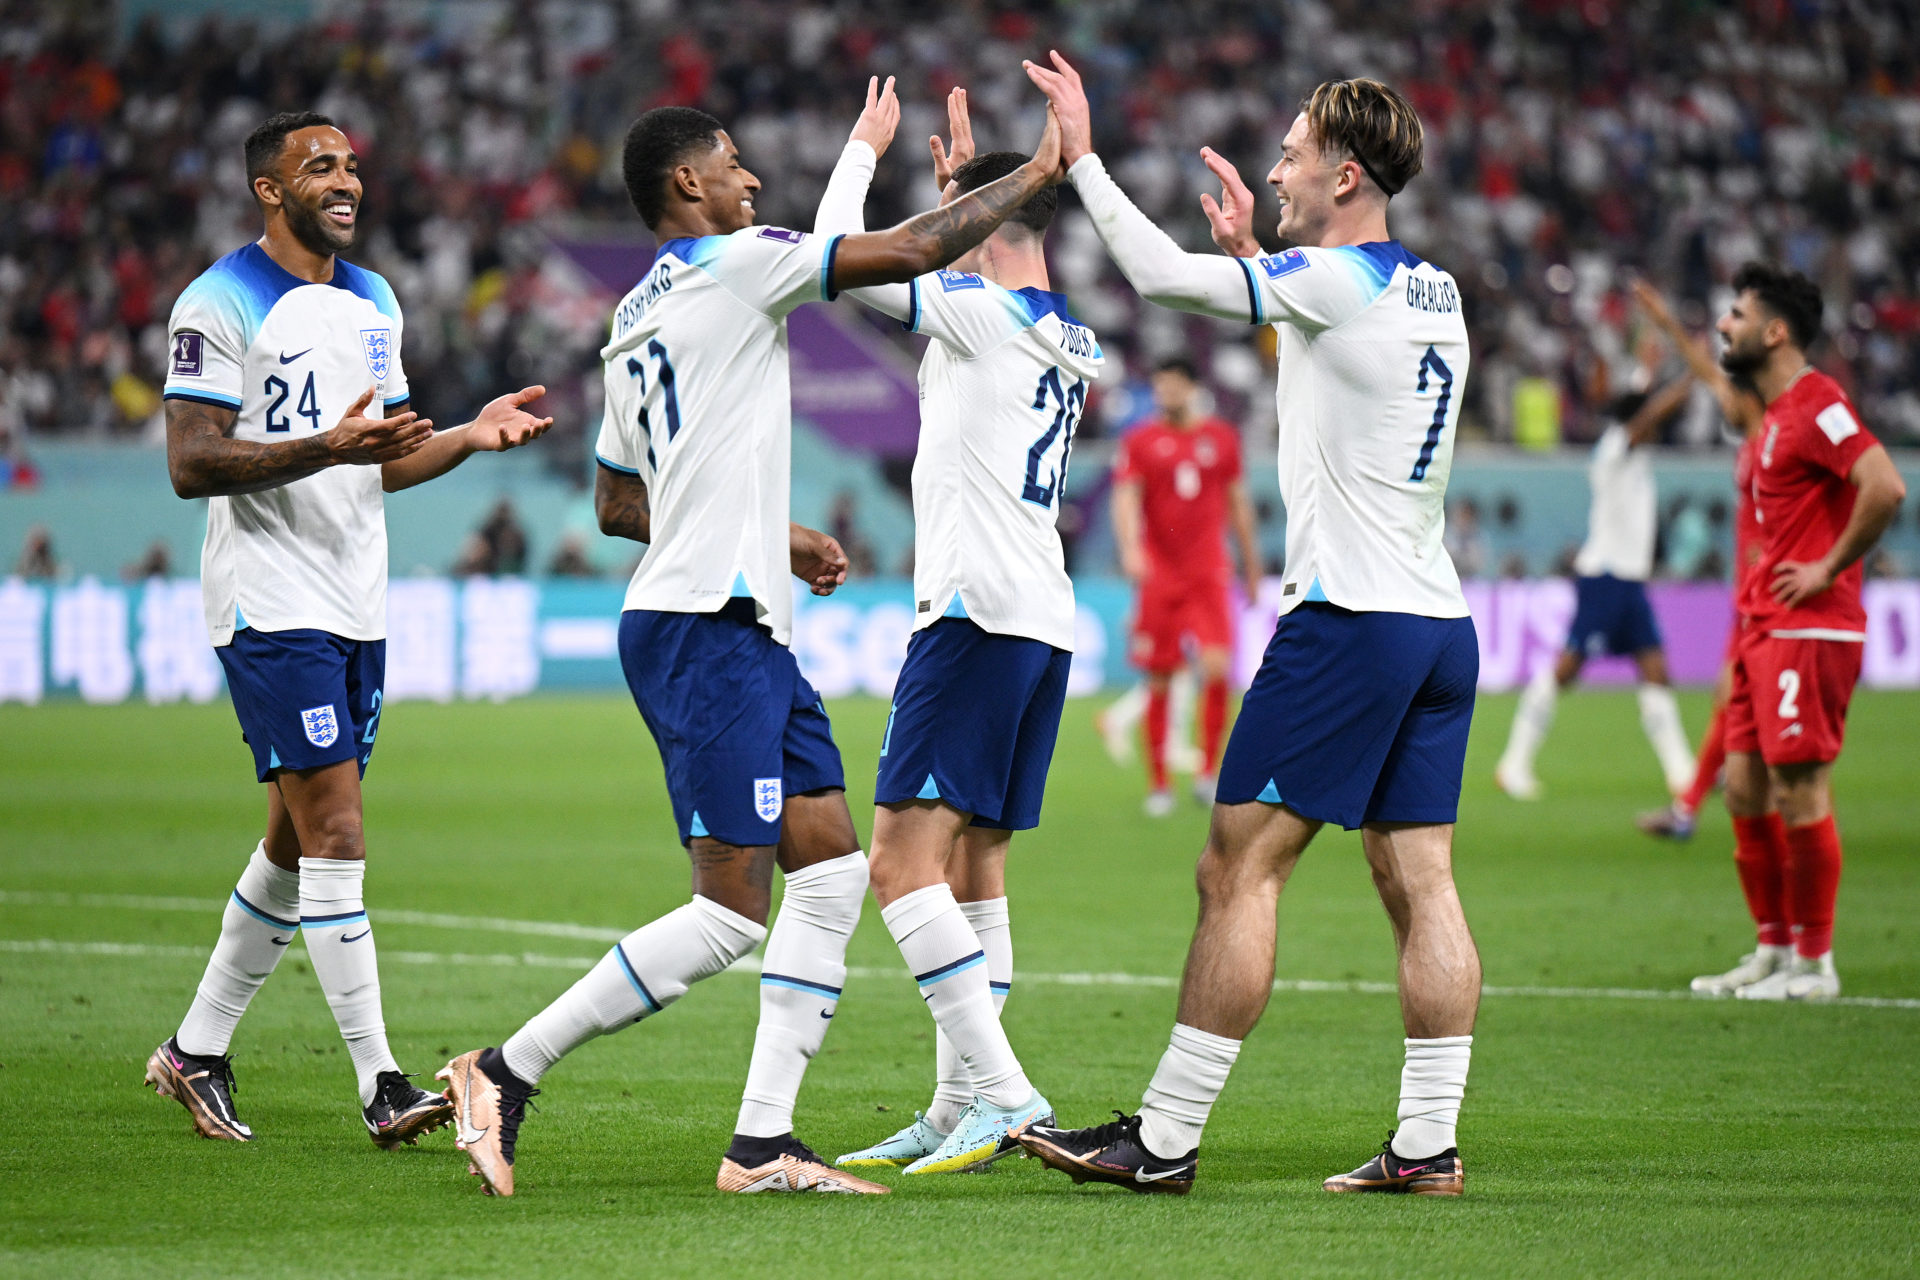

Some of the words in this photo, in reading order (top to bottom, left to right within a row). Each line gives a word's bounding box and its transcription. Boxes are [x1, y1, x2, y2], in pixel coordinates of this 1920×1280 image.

[1407, 274, 1459, 313] GREALISH
[264, 370, 321, 433] 24
[626, 337, 682, 475] 11
[1408, 343, 1453, 482] 7
[1777, 668, 1801, 719] 2
